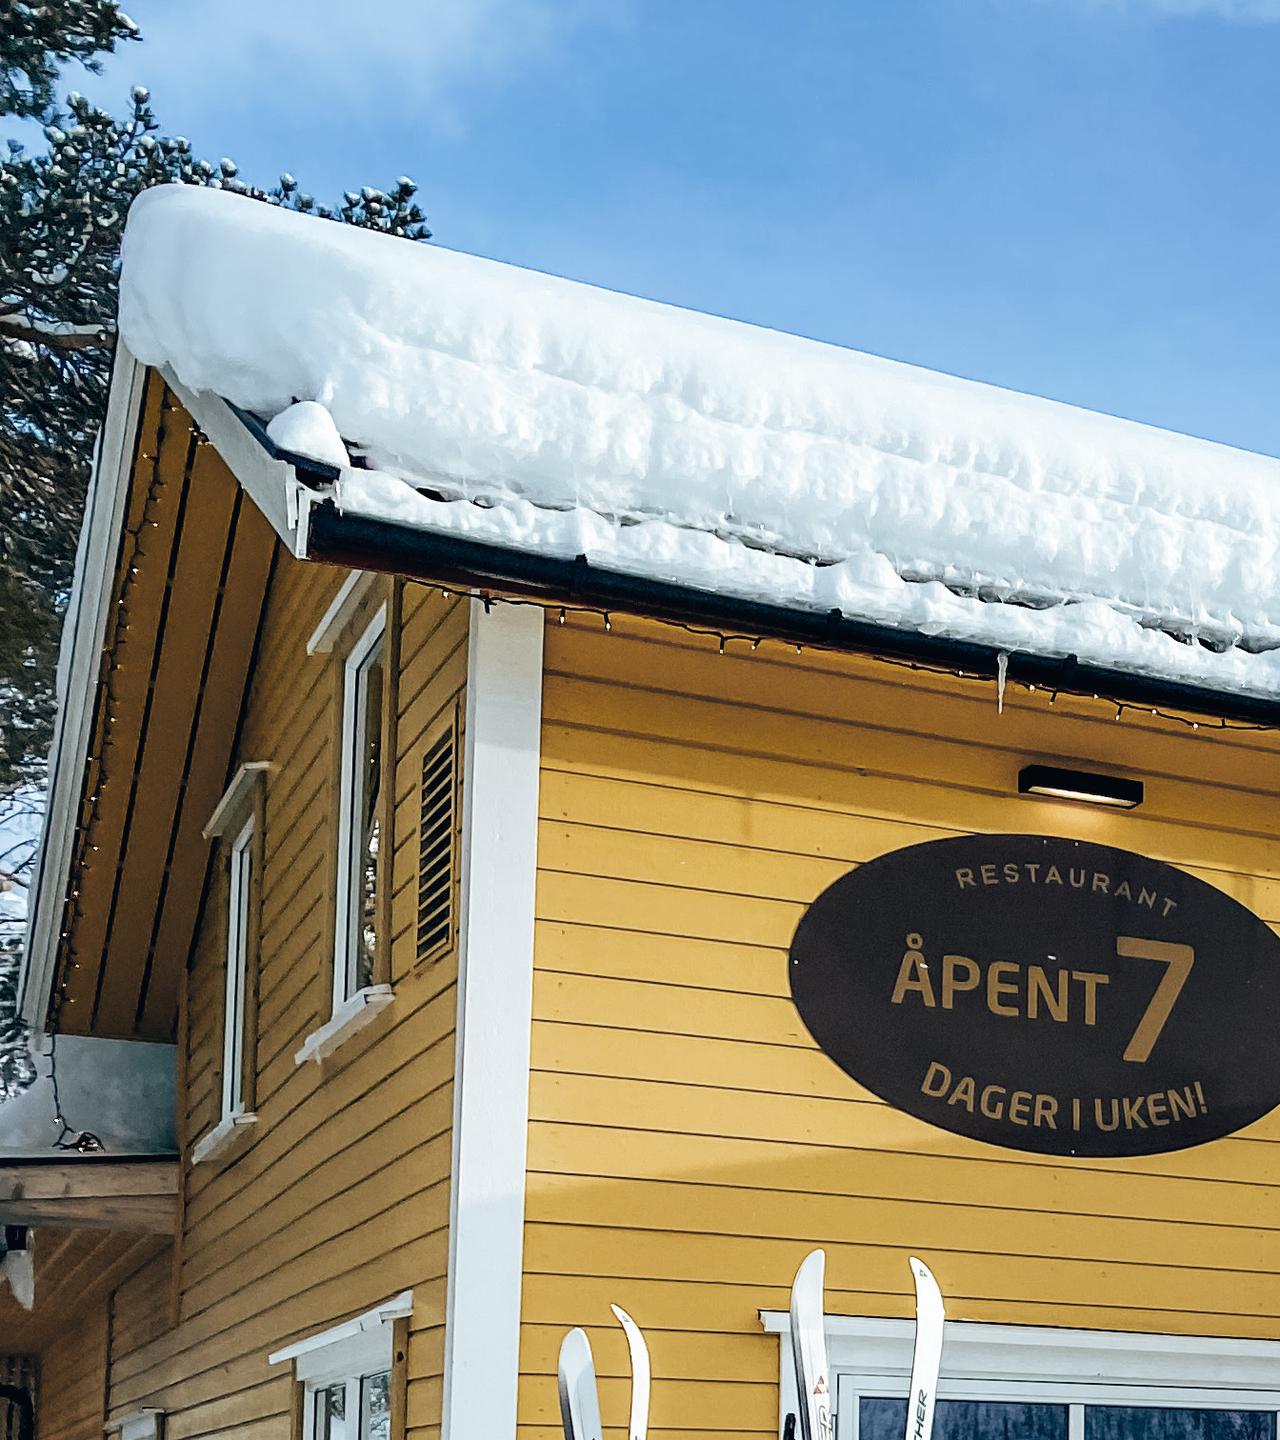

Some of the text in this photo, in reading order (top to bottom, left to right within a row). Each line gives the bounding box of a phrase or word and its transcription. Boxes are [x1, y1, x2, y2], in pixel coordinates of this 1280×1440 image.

[955, 863, 1178, 917] RESTAURANT
[890, 932, 1195, 1064] ÅPENT 7
[920, 1060, 1208, 1132] DAGER I UKEN!
